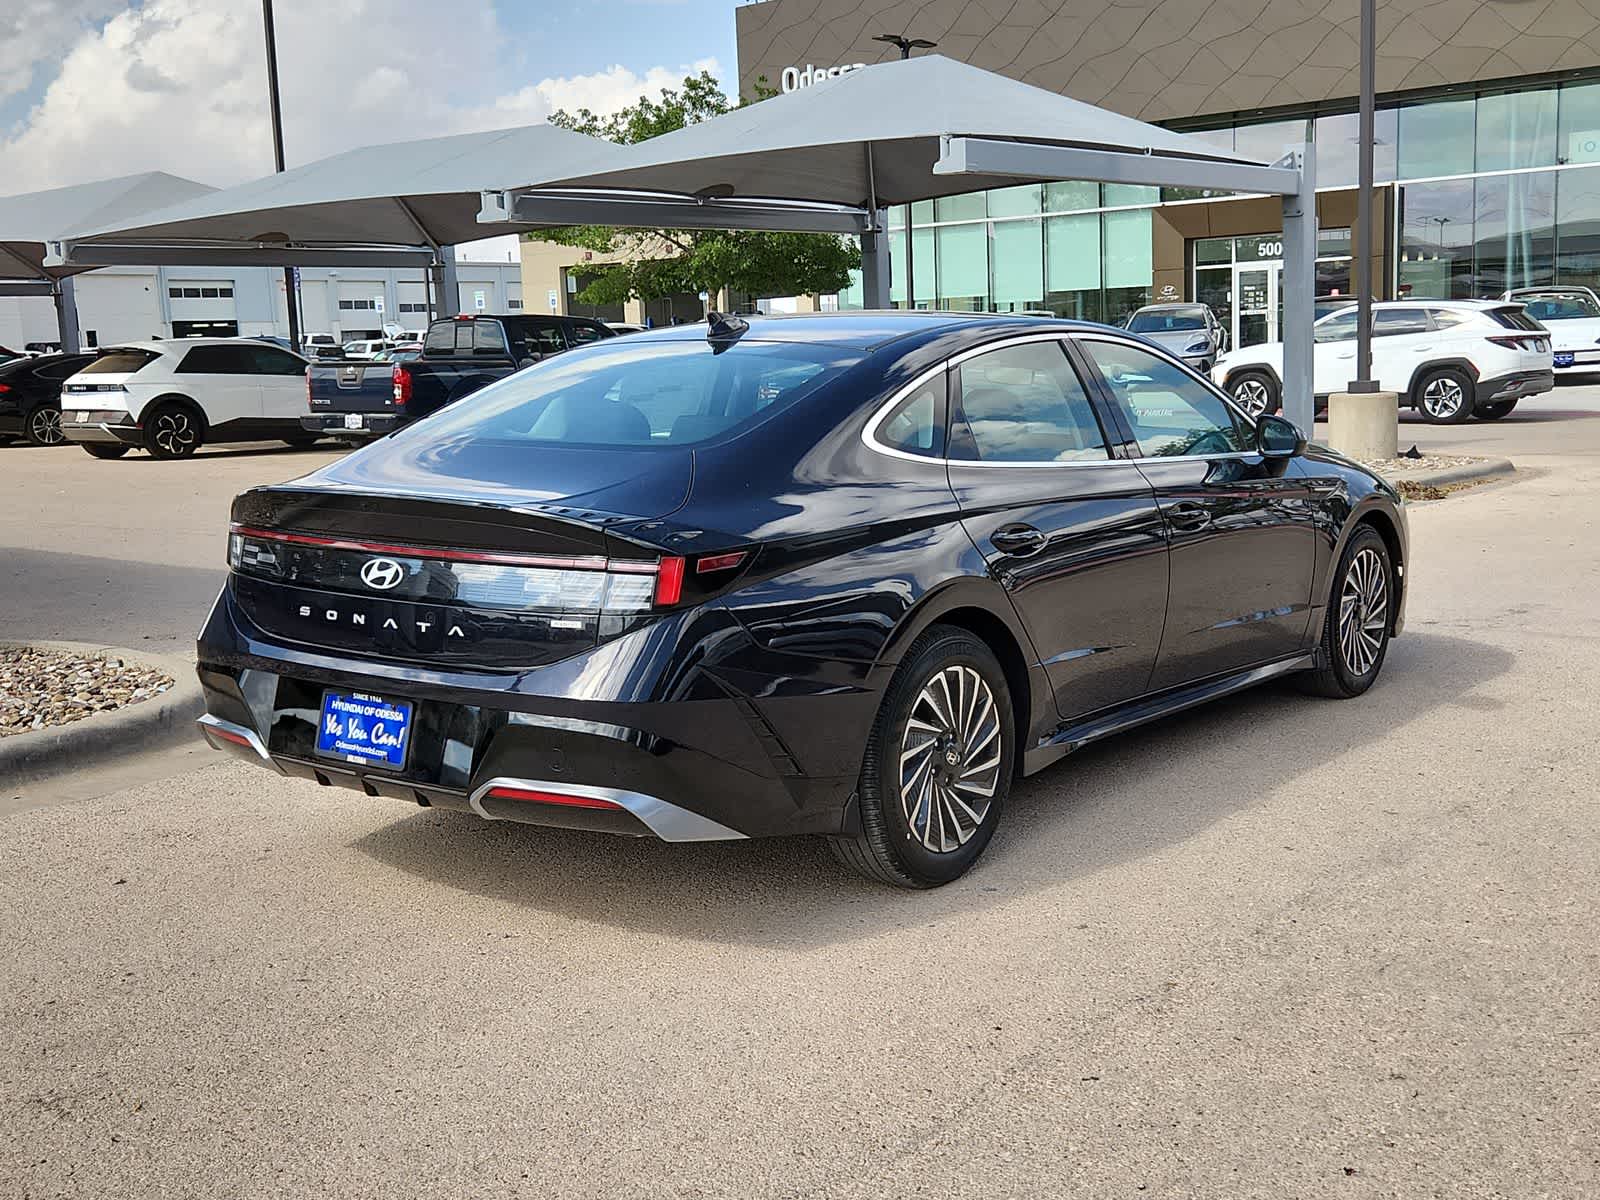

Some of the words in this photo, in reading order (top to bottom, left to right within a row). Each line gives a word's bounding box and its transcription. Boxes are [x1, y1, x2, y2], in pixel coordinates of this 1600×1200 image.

[1258, 242, 1283, 256] 500
[299, 606, 465, 637] SONATA
[332, 701, 363, 713] HYUNDAI
[364, 705, 375, 716] OF
[376, 709, 403, 721] ODESSA
[326, 714, 342, 735] Yes
[348, 718, 367, 739] You
[371, 723, 405, 748] Can!
